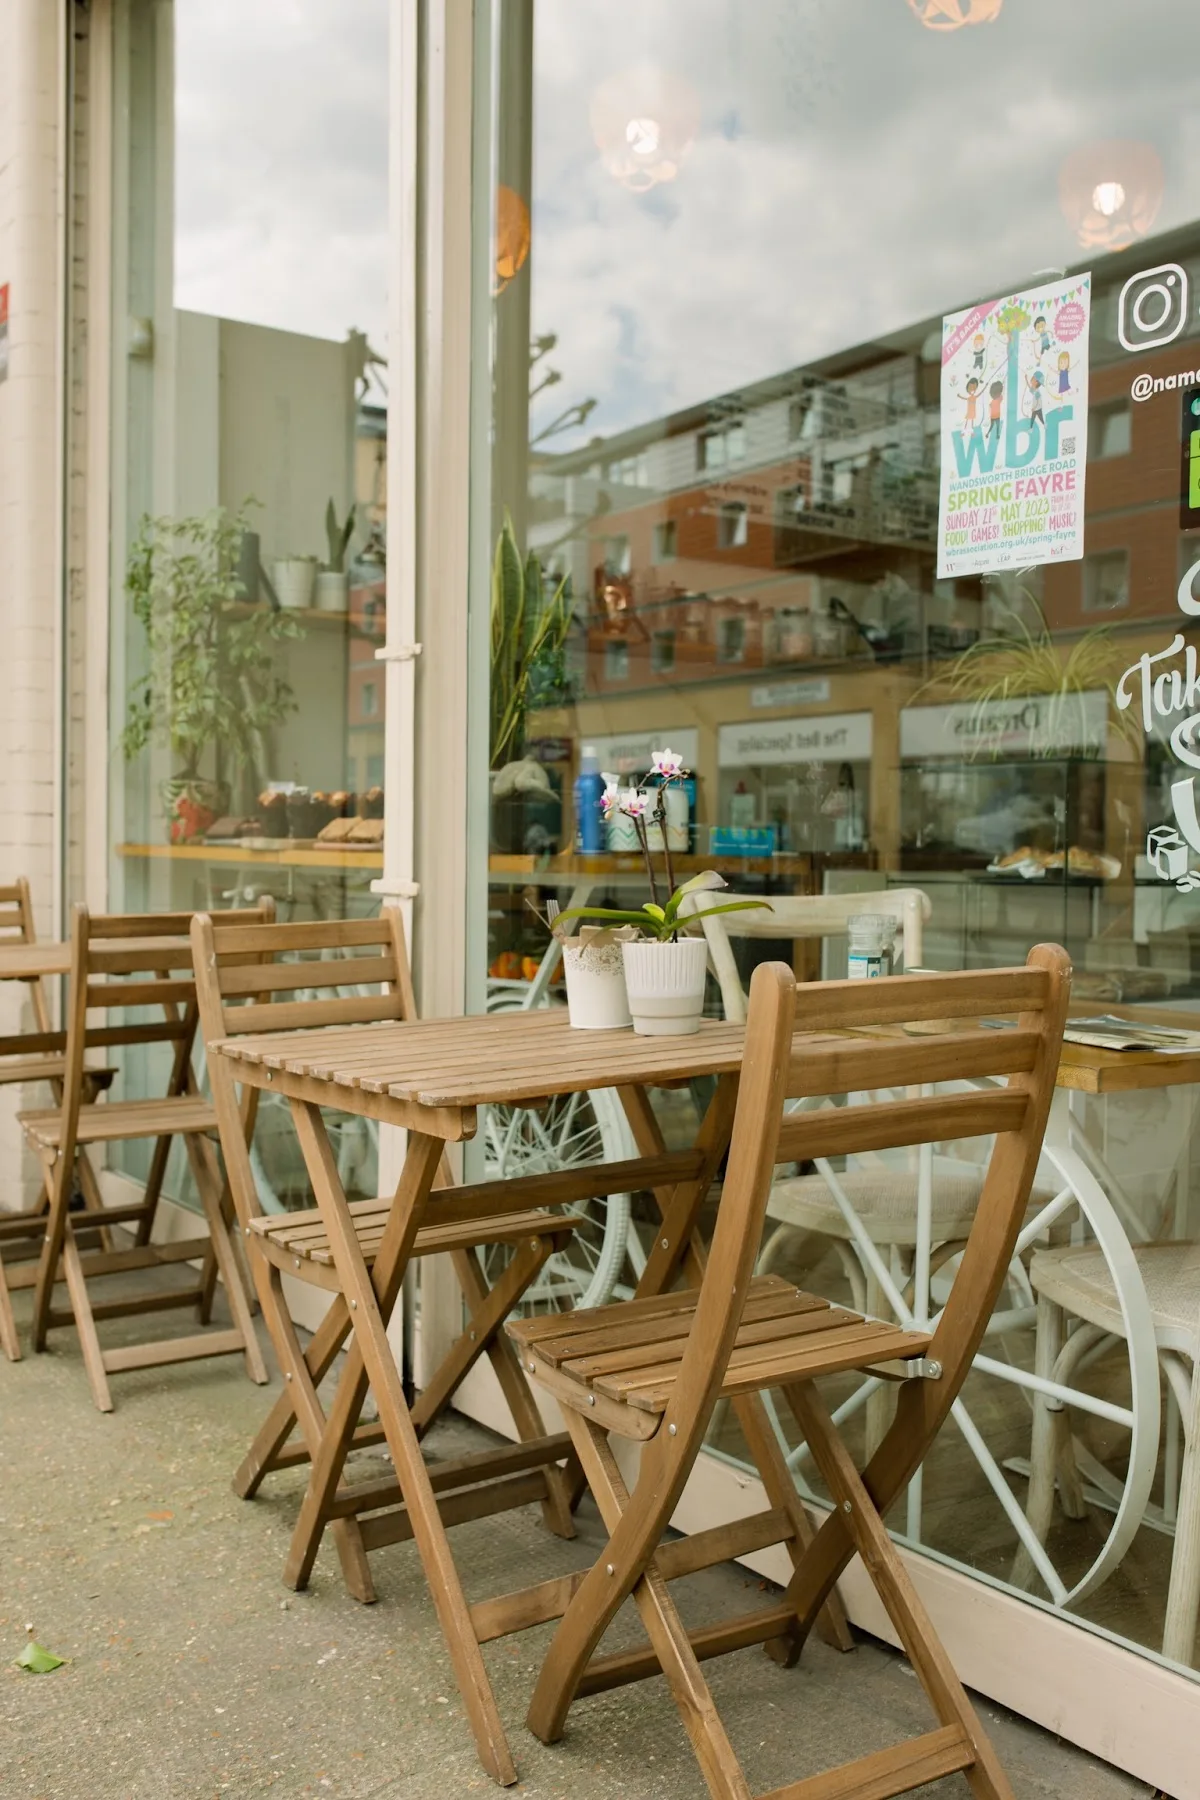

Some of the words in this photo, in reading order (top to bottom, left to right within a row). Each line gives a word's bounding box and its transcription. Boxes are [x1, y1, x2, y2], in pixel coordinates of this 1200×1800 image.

[959, 312, 981, 339] BACK!
[948, 482, 1012, 512] SPRING
[1015, 470, 1076, 500] FAYRE
[949, 471, 1012, 492] WANDSWORTH
[1014, 464, 1047, 479] BRIDGE
[1049, 459, 1076, 473] ROAD
[945, 507, 980, 532] SUNDAY
[1000, 502, 1021, 522] MAY
[1025, 498, 1050, 517] 2023
[945, 530, 968, 547] FOOD!
[971, 525, 1000, 543] GAMES!
[1002, 517, 1046, 537] SHOPPING!
[945, 530, 1076, 557] wbrassociation.org.uk/spring-fayre
